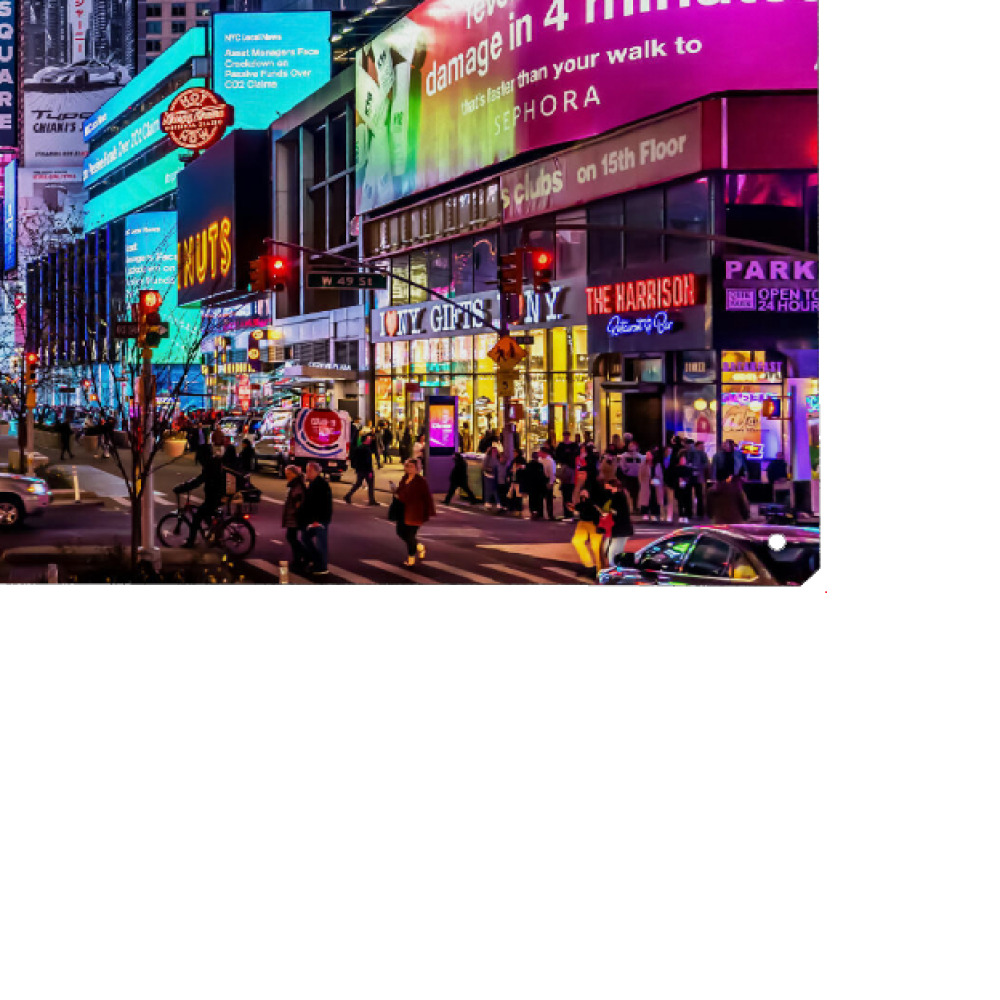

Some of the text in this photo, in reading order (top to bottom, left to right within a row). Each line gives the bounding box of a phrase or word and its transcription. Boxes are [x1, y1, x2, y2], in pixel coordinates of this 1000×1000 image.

[425, 30, 503, 97] damage
[508, 12, 533, 51] in
[517, 65, 549, 89] than
[553, 51, 601, 81] your
[606, 38, 668, 66] walk
[674, 36, 703, 56] to
[494, 85, 601, 136] SEPHORA
[514, 166, 564, 207] clubs
[576, 164, 597, 185] on
[602, 147, 636, 177] 15th
[640, 133, 687, 166] Floor
[178, 216, 232, 291] NUTS
[725, 260, 815, 280] PARK
[321, 275, 333, 286] W
[337, 276, 355, 286] 49
[585, 284, 612, 315] THE
[614, 272, 695, 313] HARRISON
[757, 288, 800, 301] OPEN
[430, 298, 485, 332] GIFTS
[757, 300, 775, 312] 24
